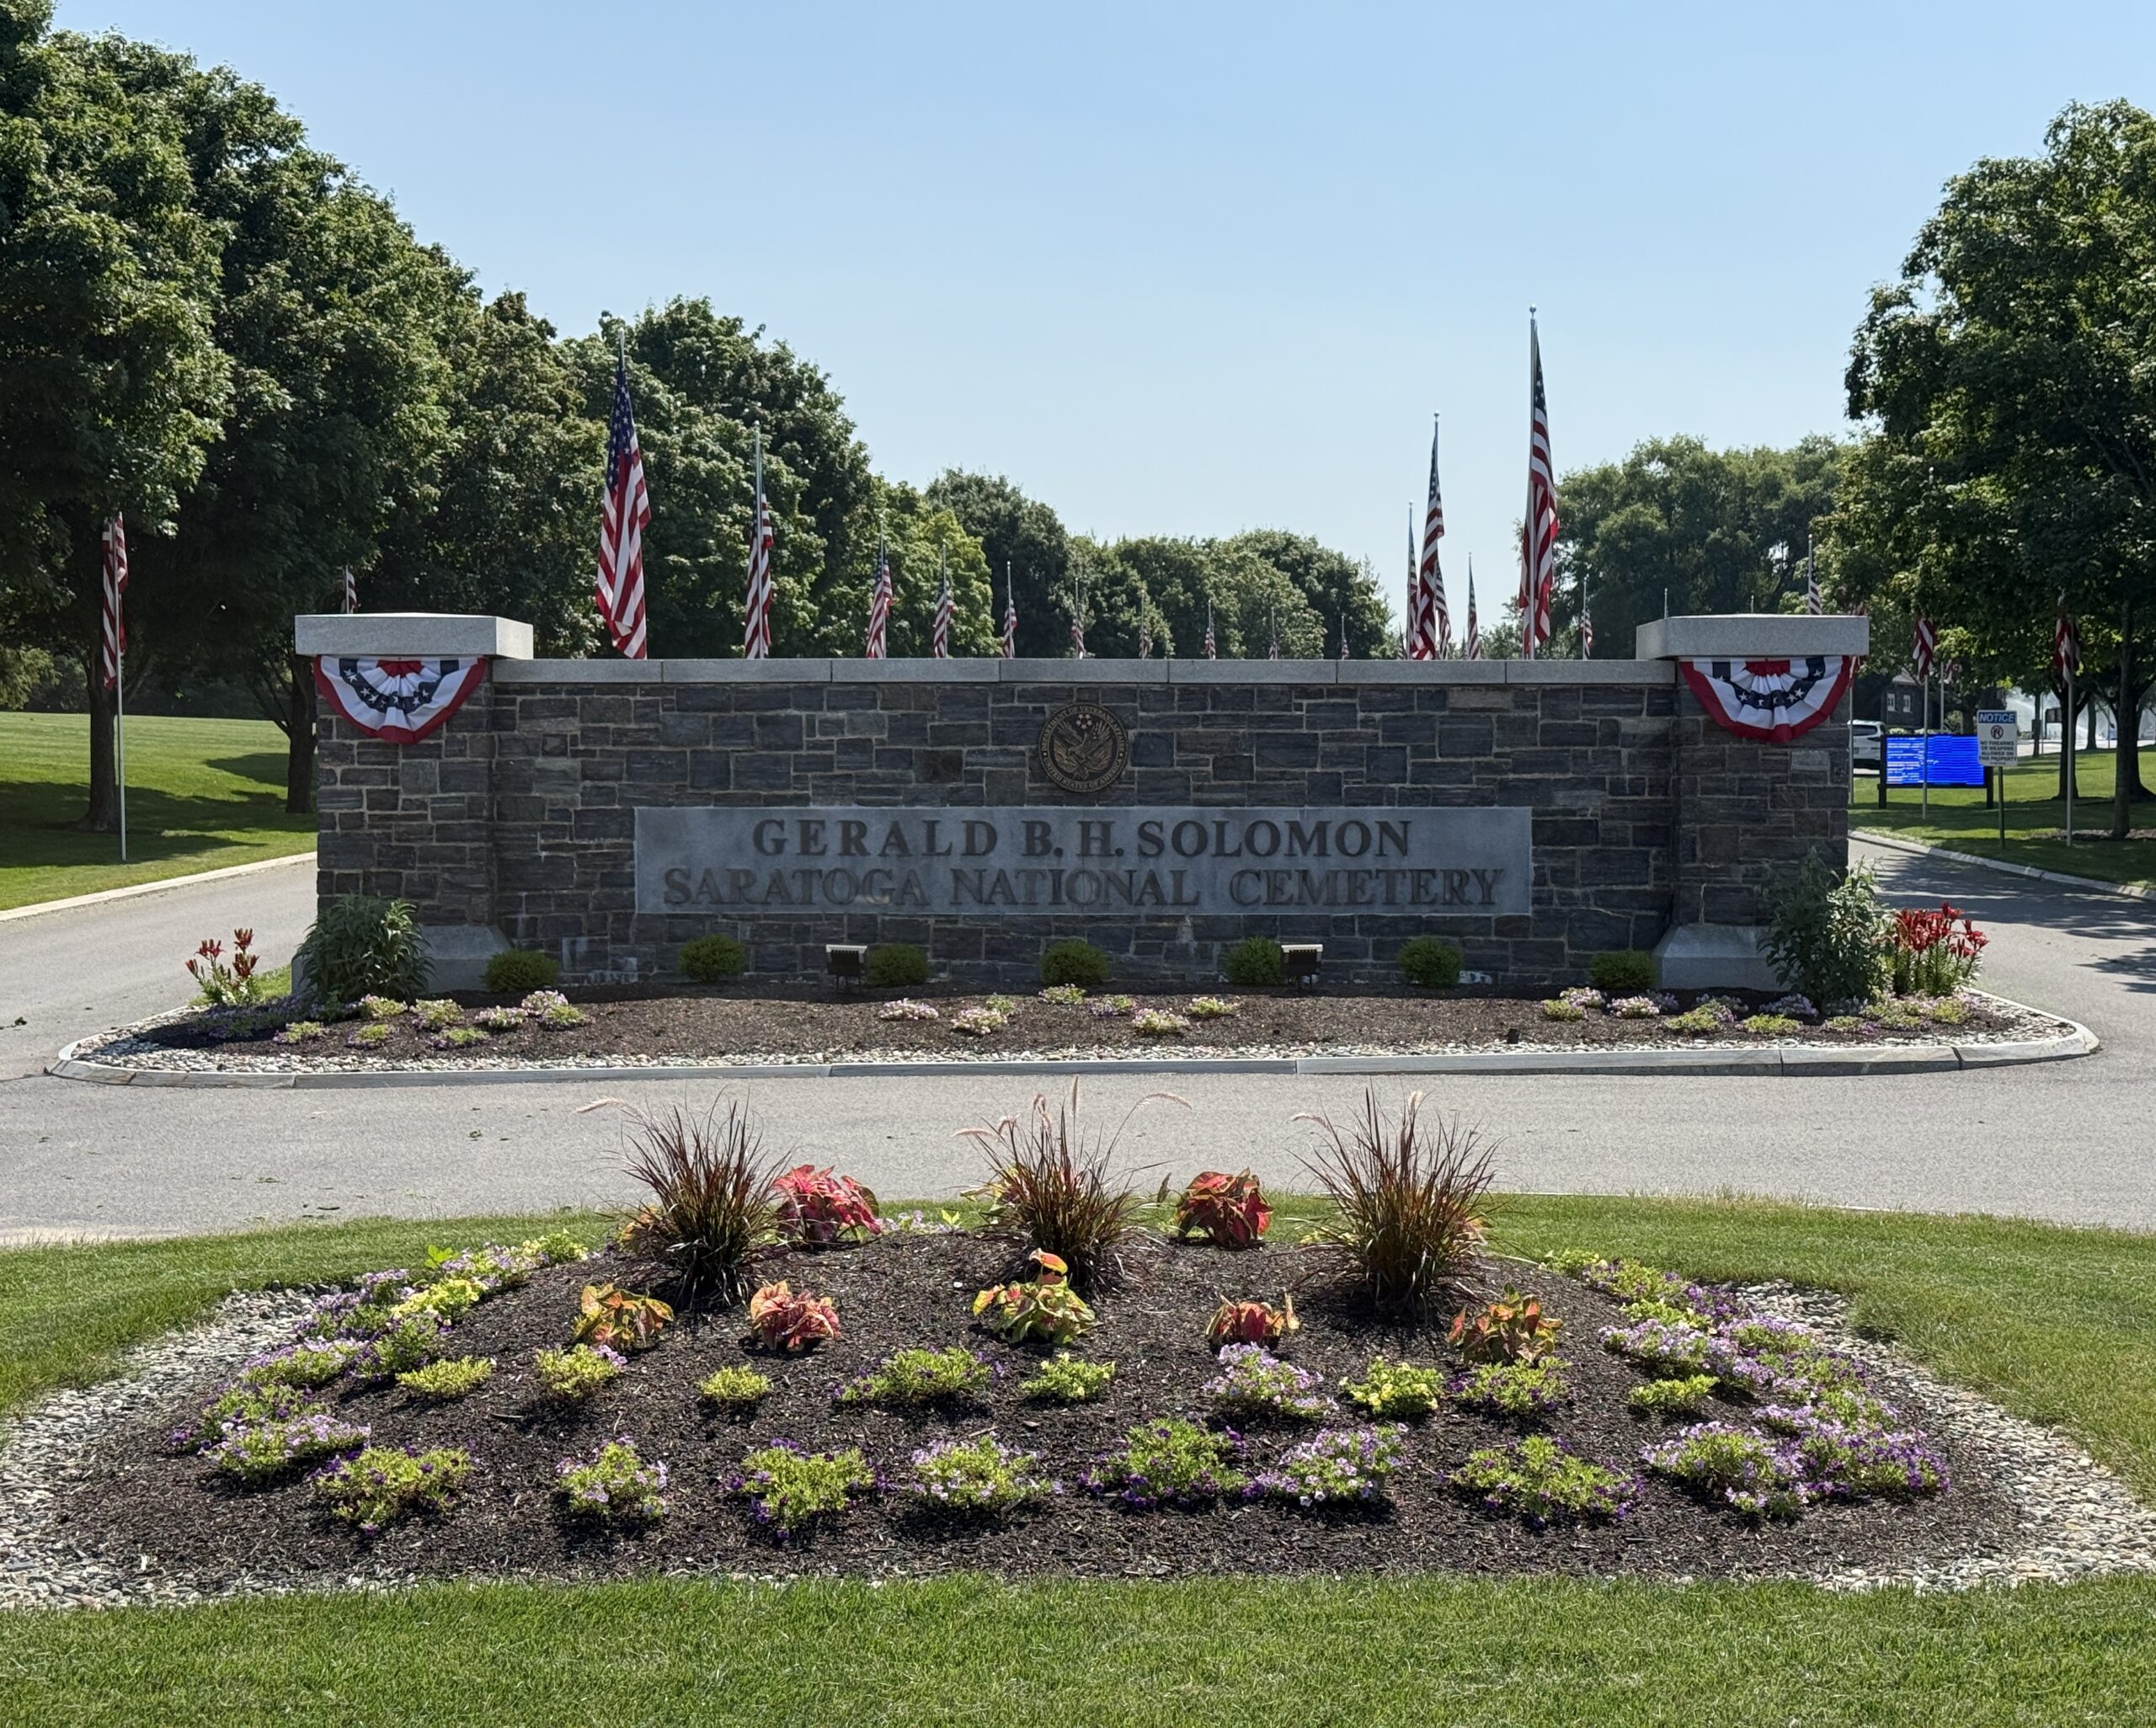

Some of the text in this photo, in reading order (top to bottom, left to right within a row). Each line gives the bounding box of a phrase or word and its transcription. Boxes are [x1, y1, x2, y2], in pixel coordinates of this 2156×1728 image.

[1980, 713, 2015, 722] NOTICE
[1043, 756, 1063, 781] UNITED
[1088, 780, 1098, 788] OF
[1098, 758, 1123, 785] AMERICA
[752, 819, 1412, 858] GERALD B. H. SOLOMON
[663, 866, 1504, 907] SARATOGA NATIONAL CEMETERY
